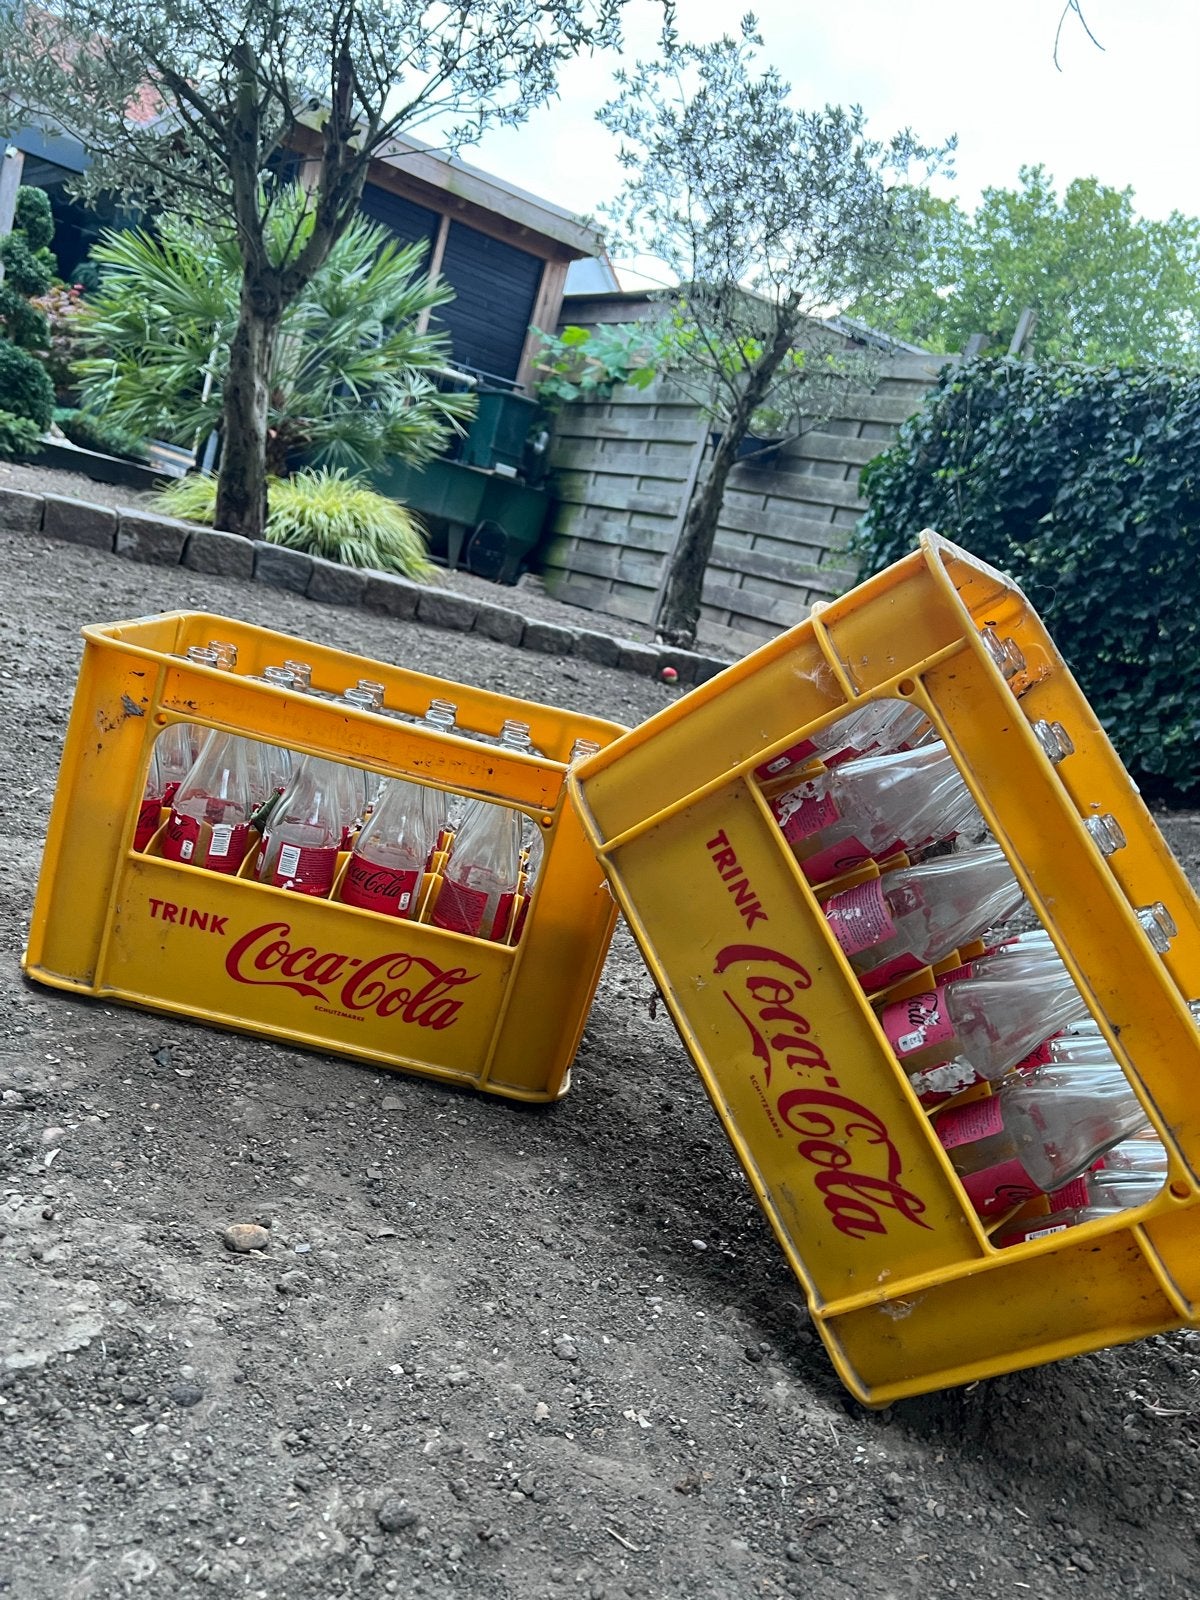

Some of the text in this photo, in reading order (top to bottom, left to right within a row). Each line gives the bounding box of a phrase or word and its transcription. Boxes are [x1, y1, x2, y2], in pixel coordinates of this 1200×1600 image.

[149, 898, 228, 936] TRINK
[706, 830, 768, 929] TRINK
[225, 921, 480, 1031] Coca-Cola
